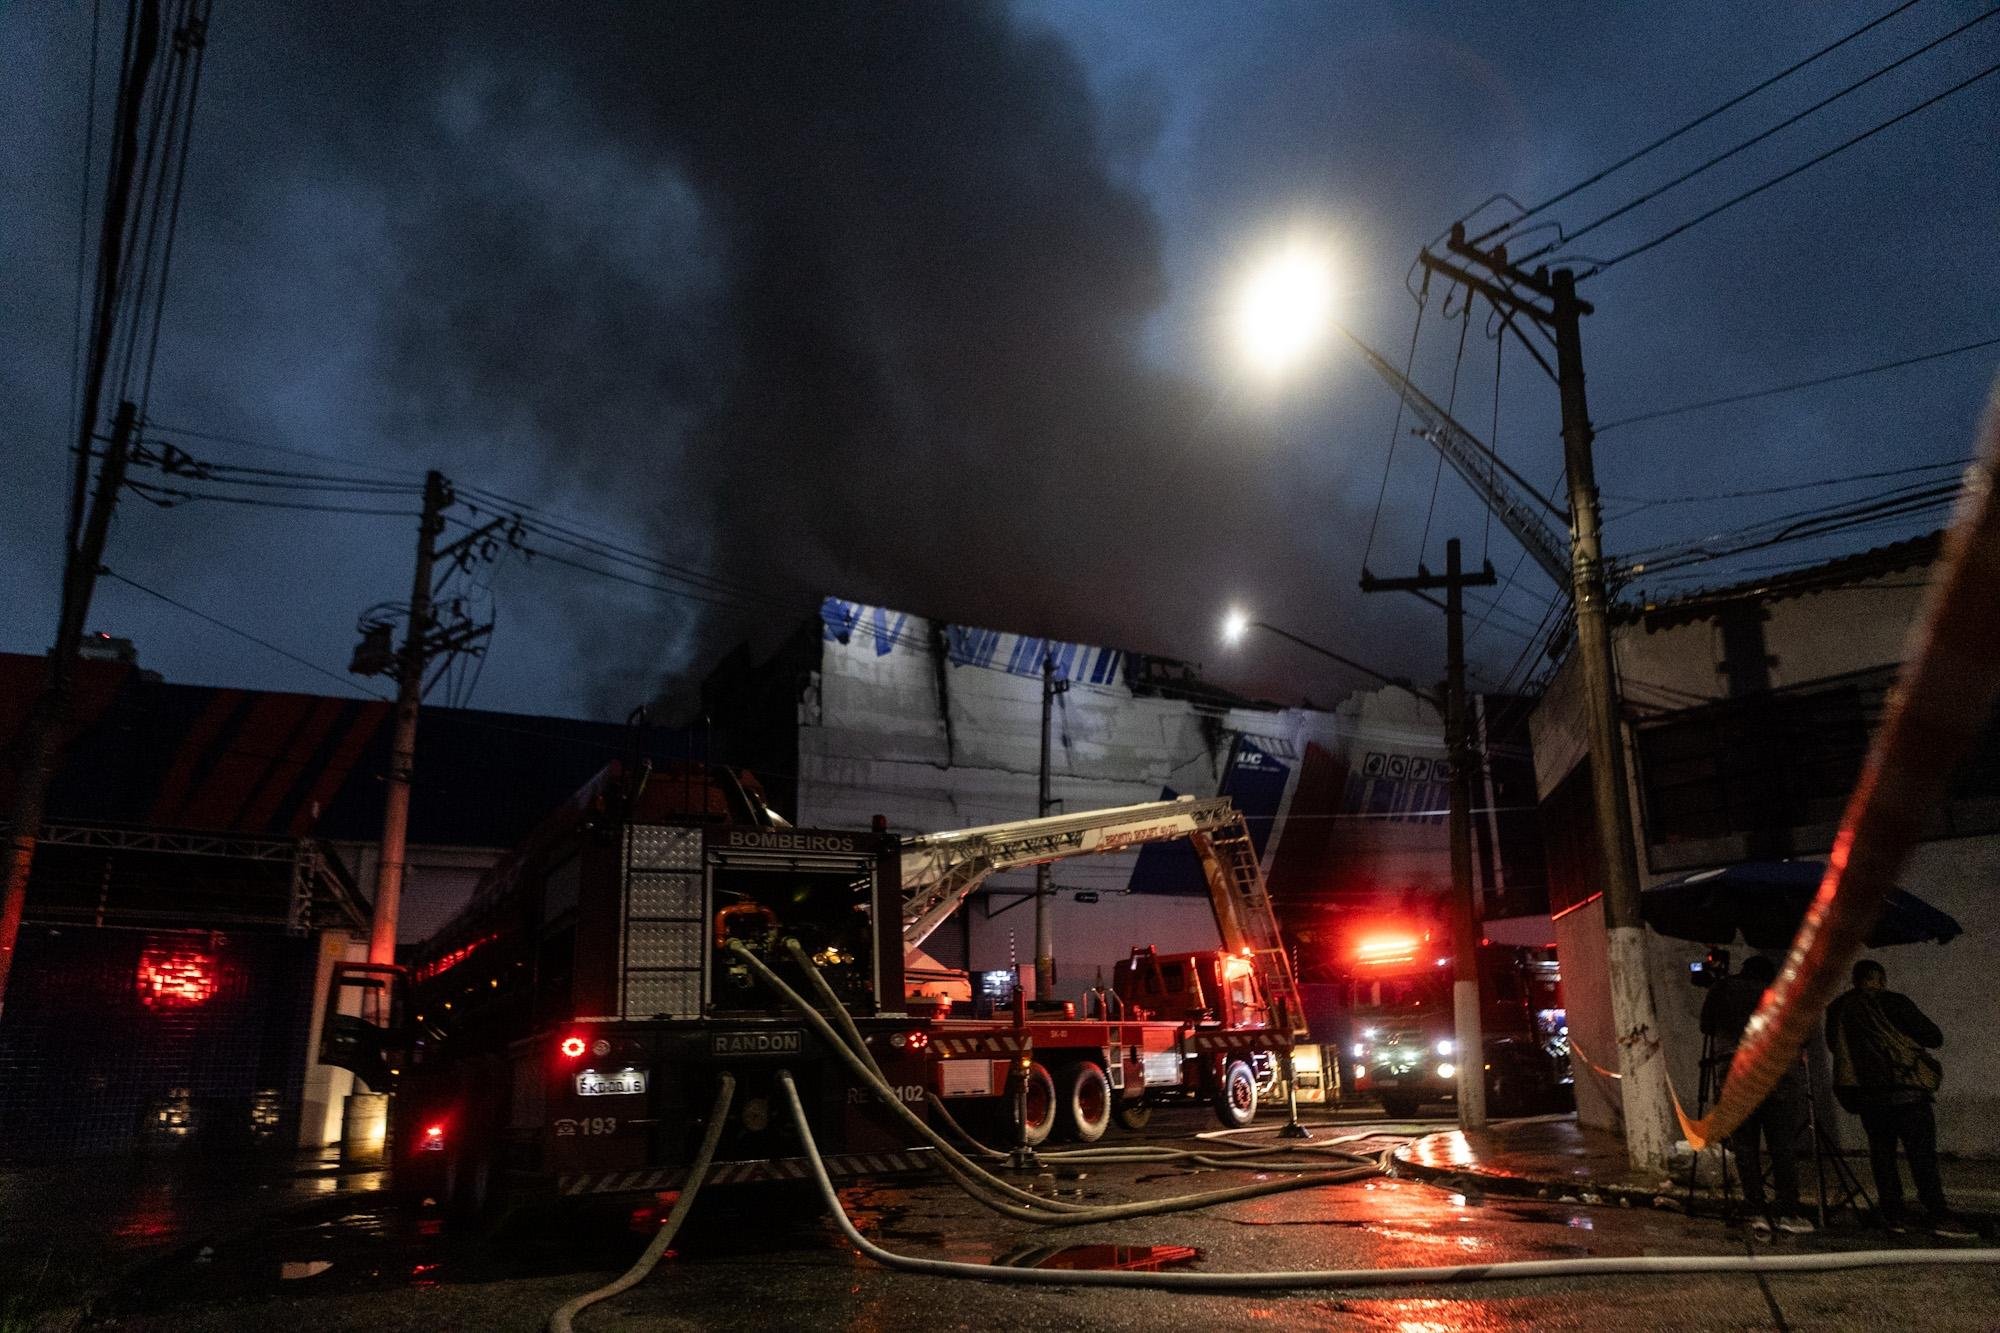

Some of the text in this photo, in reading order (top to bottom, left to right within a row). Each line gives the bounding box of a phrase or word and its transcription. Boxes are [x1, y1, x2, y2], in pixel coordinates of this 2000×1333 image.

[730, 832, 854, 851] BOMBEIROS
[715, 1035, 798, 1051] RANDON
[580, 1117, 616, 1136] 193
